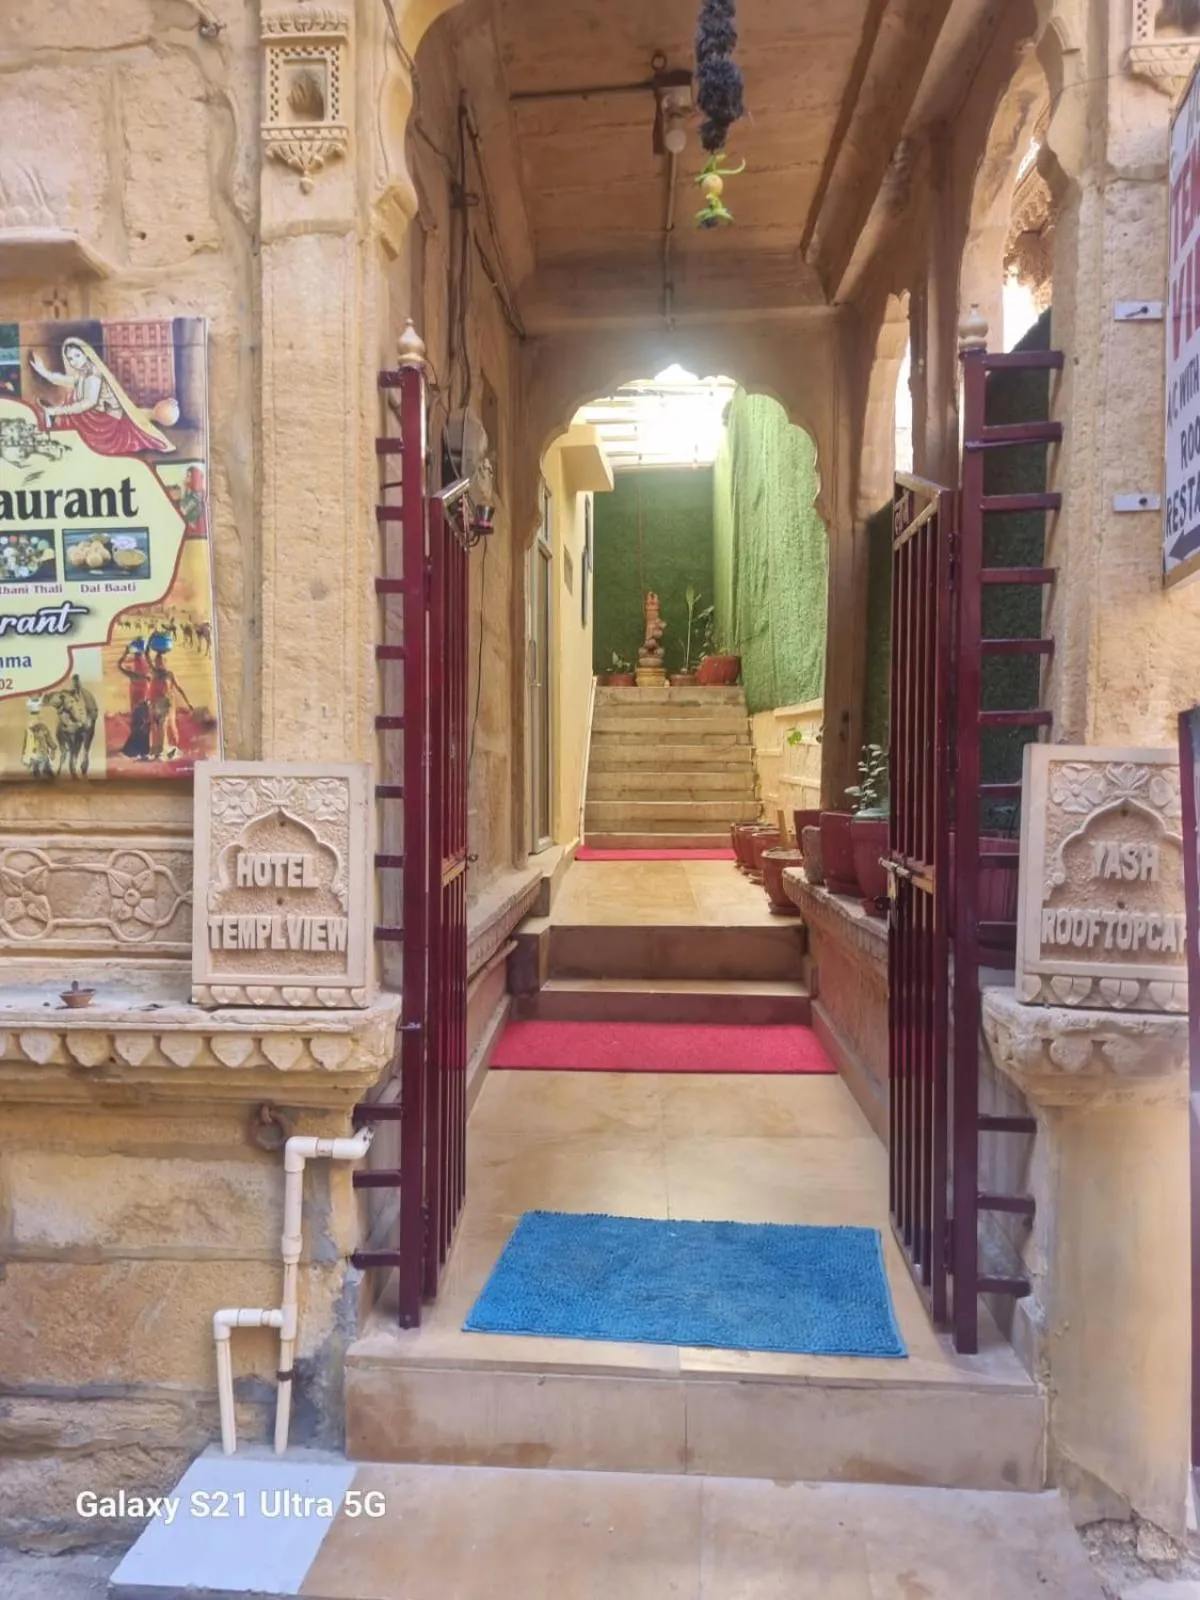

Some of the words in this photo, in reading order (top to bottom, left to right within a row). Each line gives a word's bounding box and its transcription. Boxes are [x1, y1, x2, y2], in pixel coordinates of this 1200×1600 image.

[1179, 353, 1199, 410] WITH
[81, 583, 101, 593] Dal
[105, 582, 136, 592] Baati
[236, 852, 320, 888] HOTEL
[1089, 840, 1160, 881] YASH
